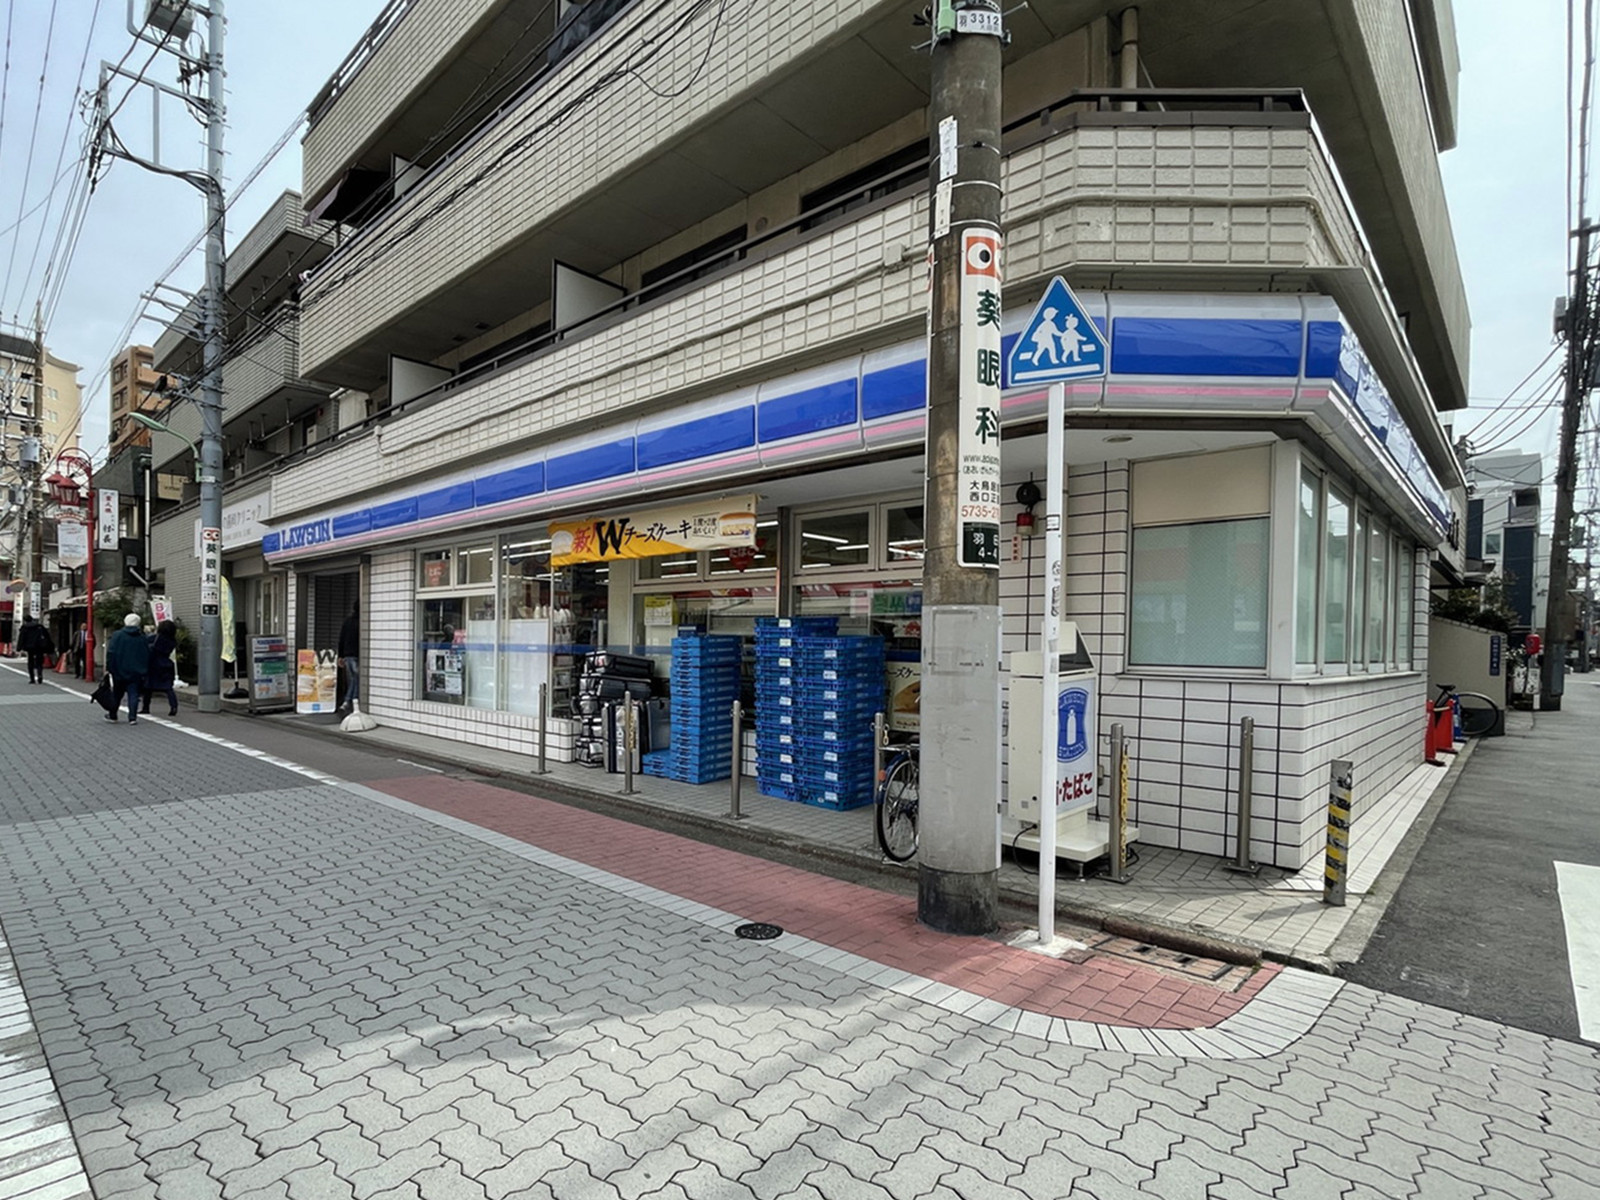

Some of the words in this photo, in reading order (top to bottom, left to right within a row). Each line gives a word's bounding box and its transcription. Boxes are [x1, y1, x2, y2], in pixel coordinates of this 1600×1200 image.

[970, 13, 999, 26] 3312
[976, 289, 1000, 447] 葵眼科
[281, 518, 330, 550] LAWSON
